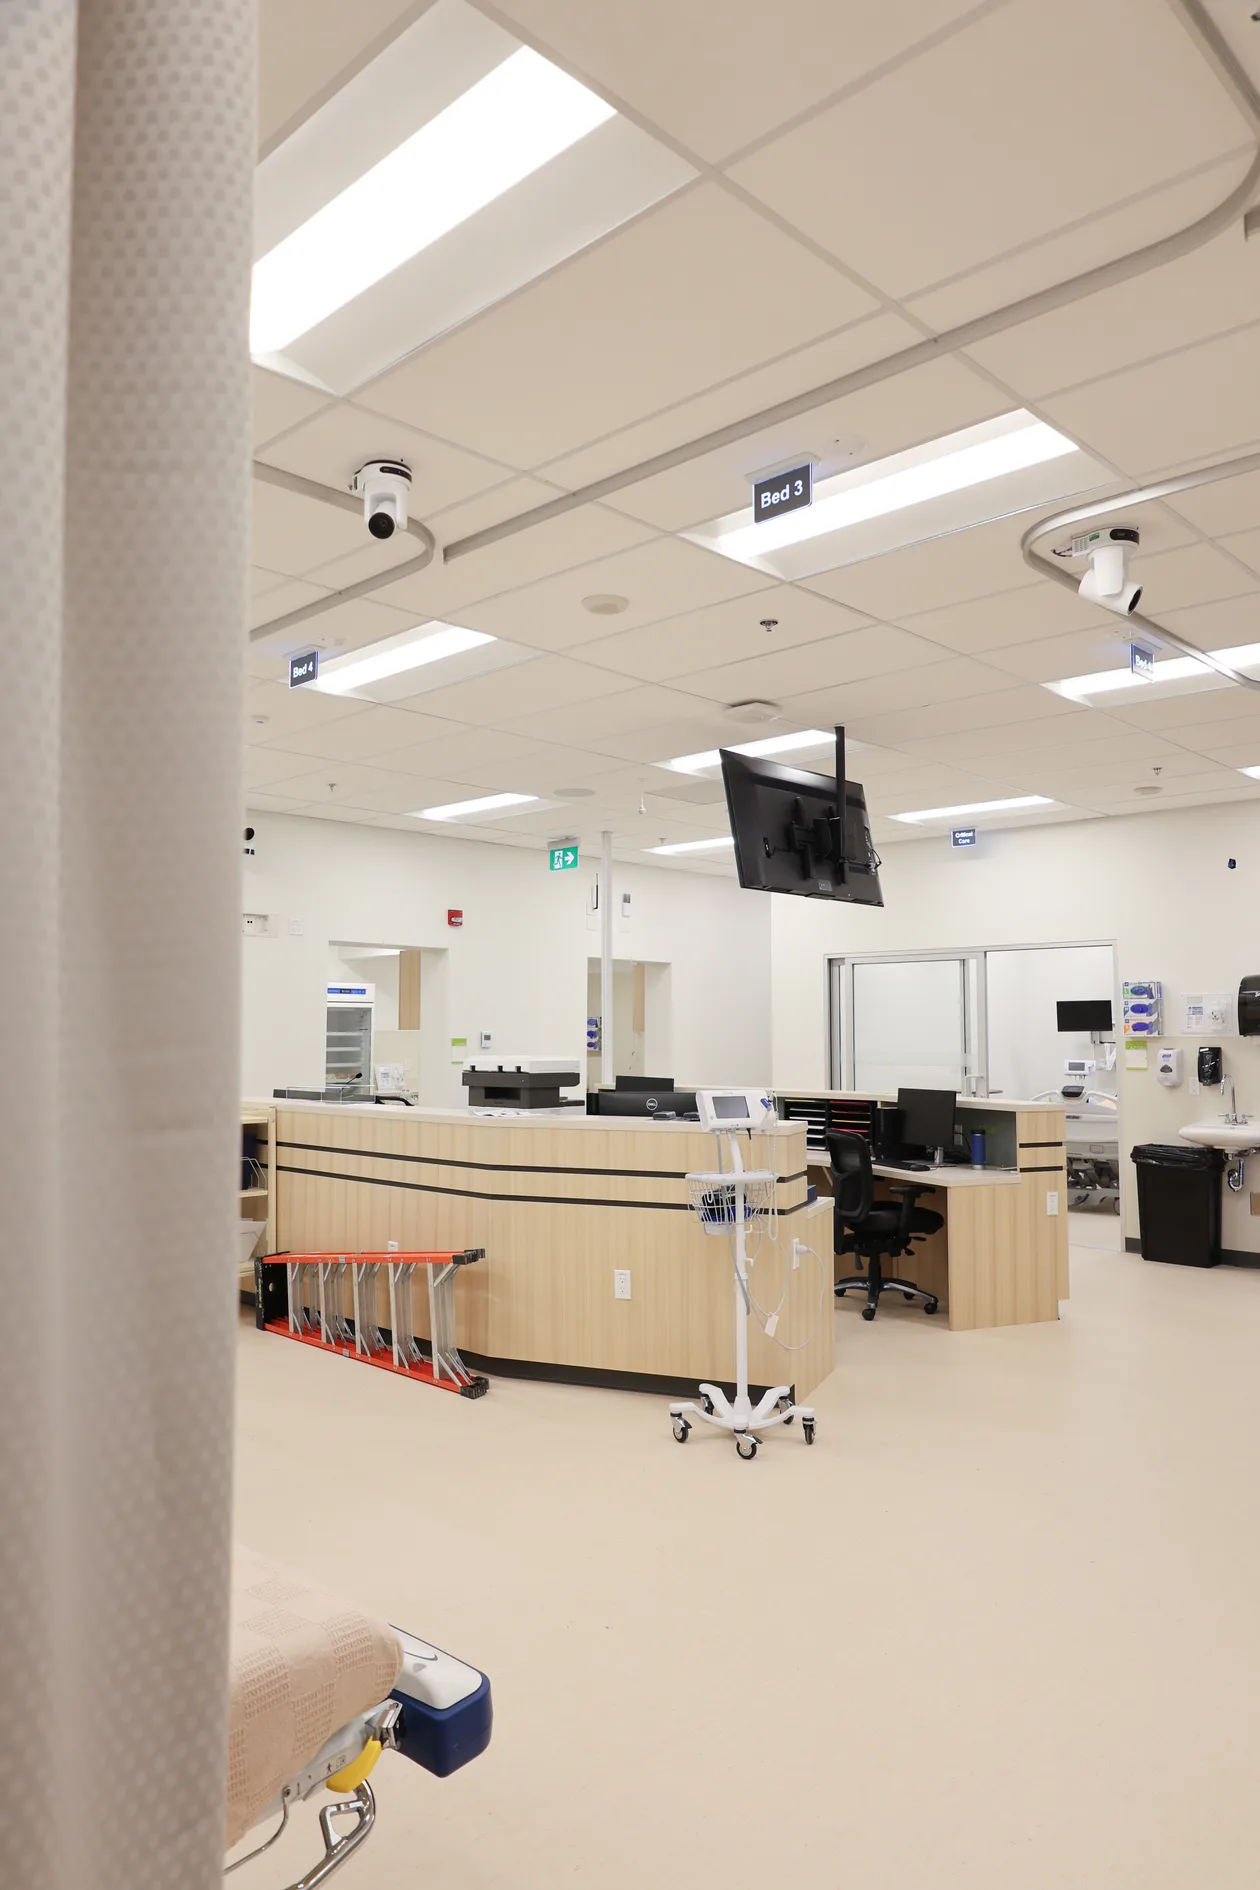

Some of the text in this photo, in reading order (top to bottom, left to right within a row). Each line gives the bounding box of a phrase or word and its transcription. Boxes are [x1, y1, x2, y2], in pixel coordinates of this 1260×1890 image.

[761, 480, 803, 509] Bed 3
[293, 661, 313, 678] Bed 4
